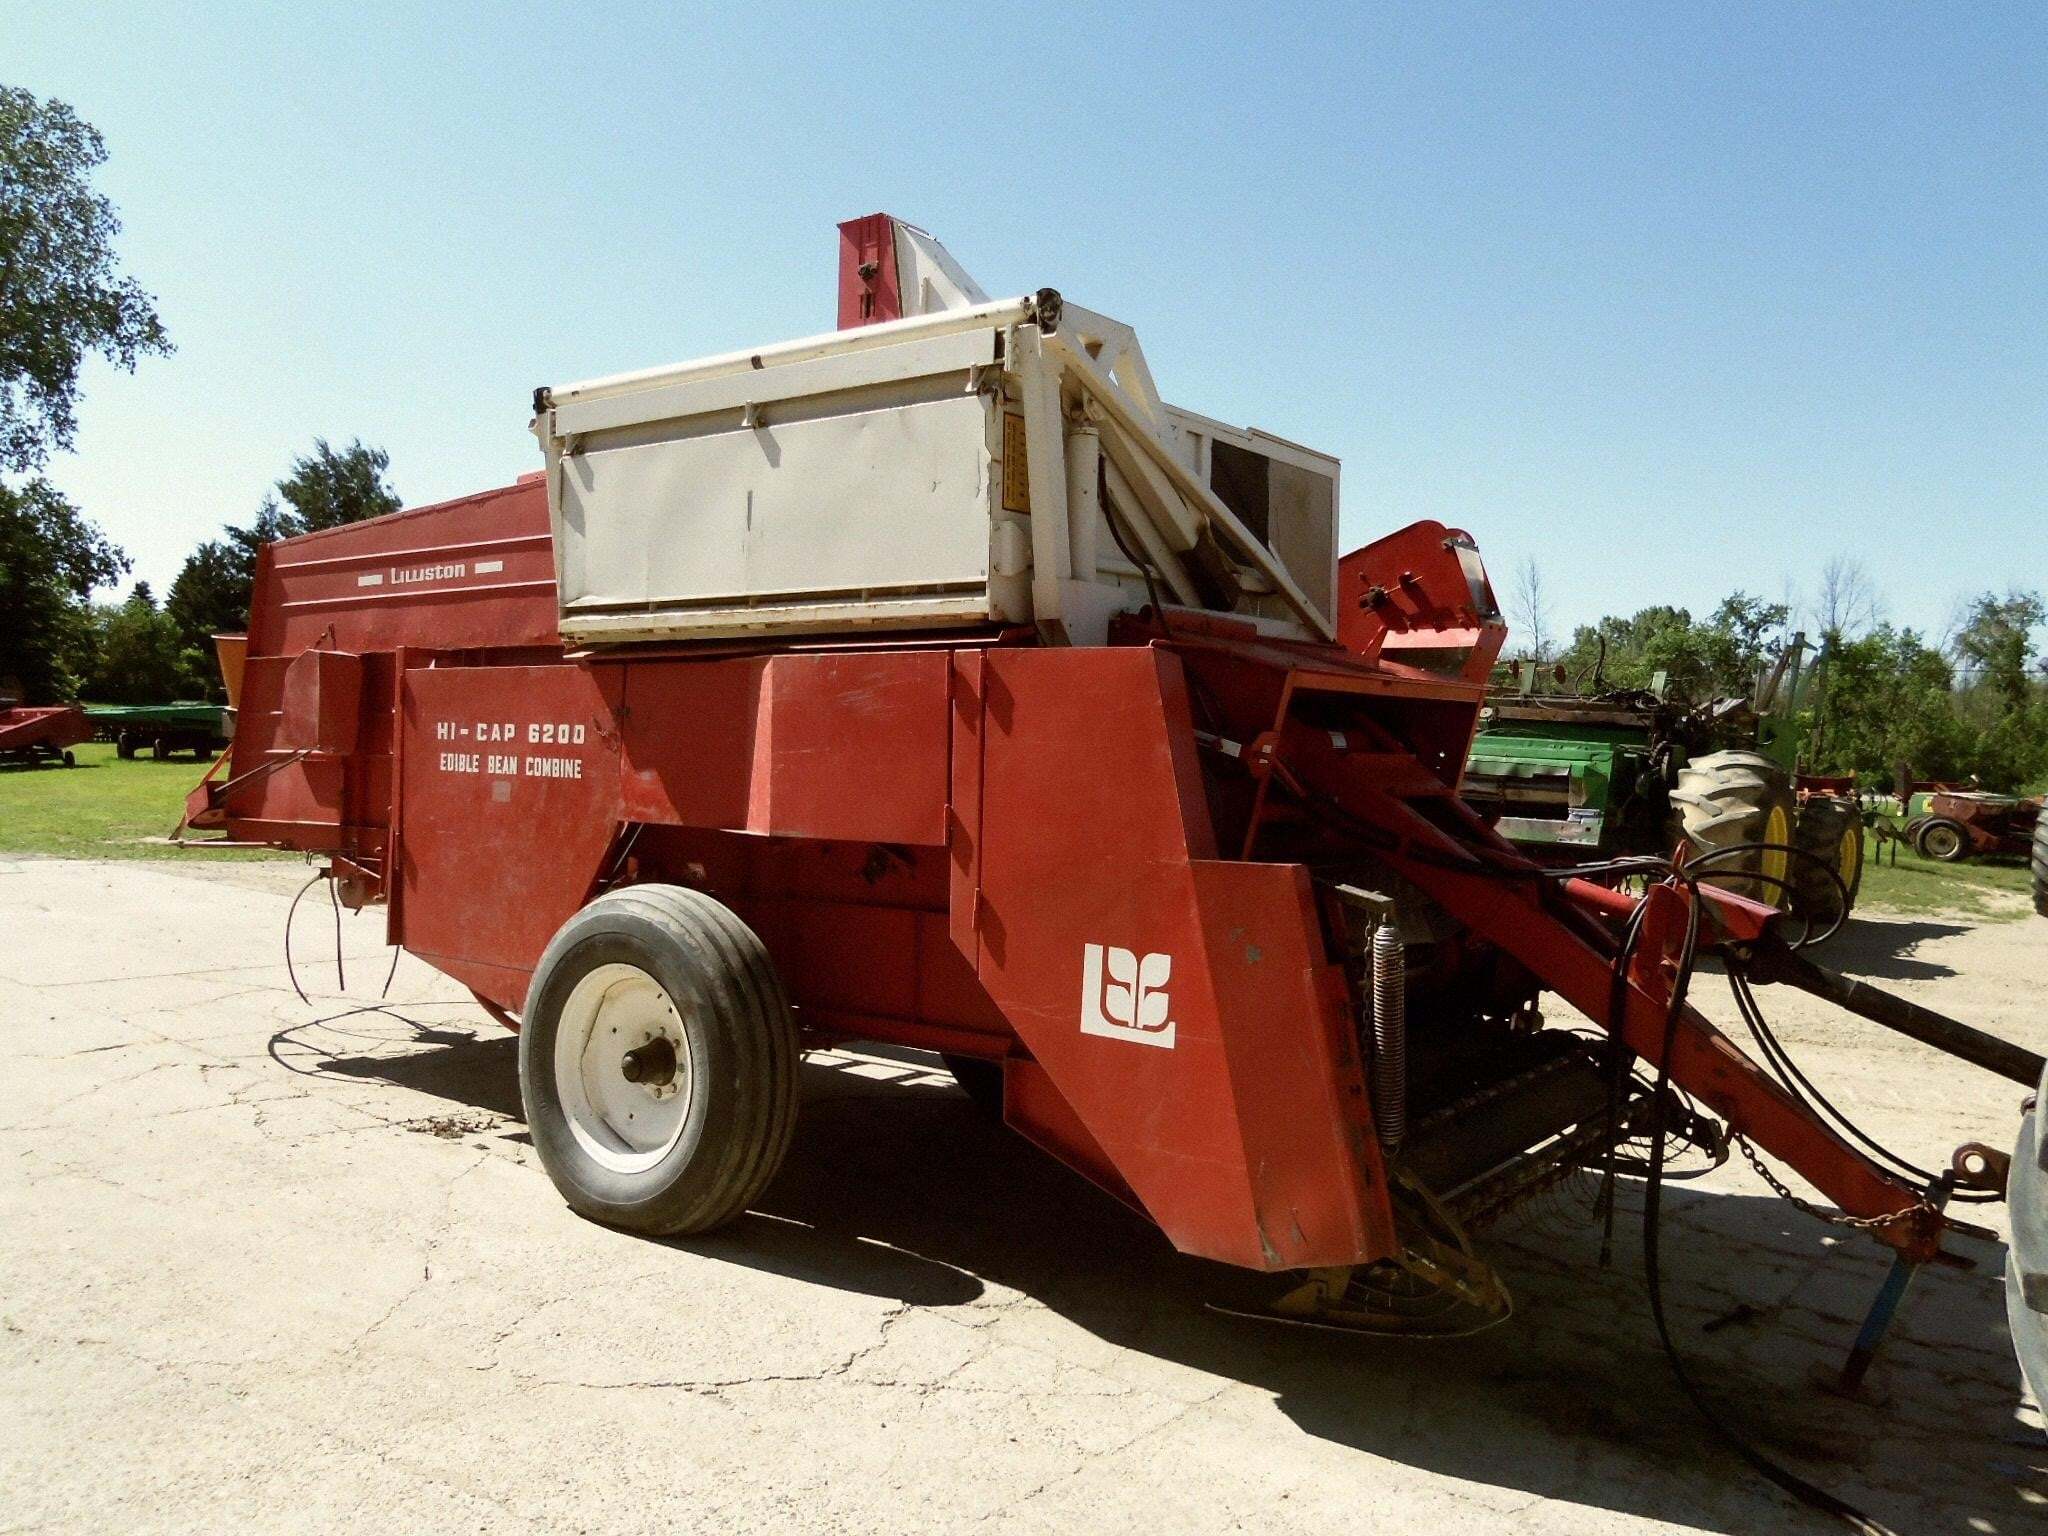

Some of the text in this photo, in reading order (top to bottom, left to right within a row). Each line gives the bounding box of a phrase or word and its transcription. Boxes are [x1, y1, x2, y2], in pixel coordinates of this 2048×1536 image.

[528, 723, 585, 745] 6200
[440, 752, 582, 779] EDIBLE BEAN COMBINE
